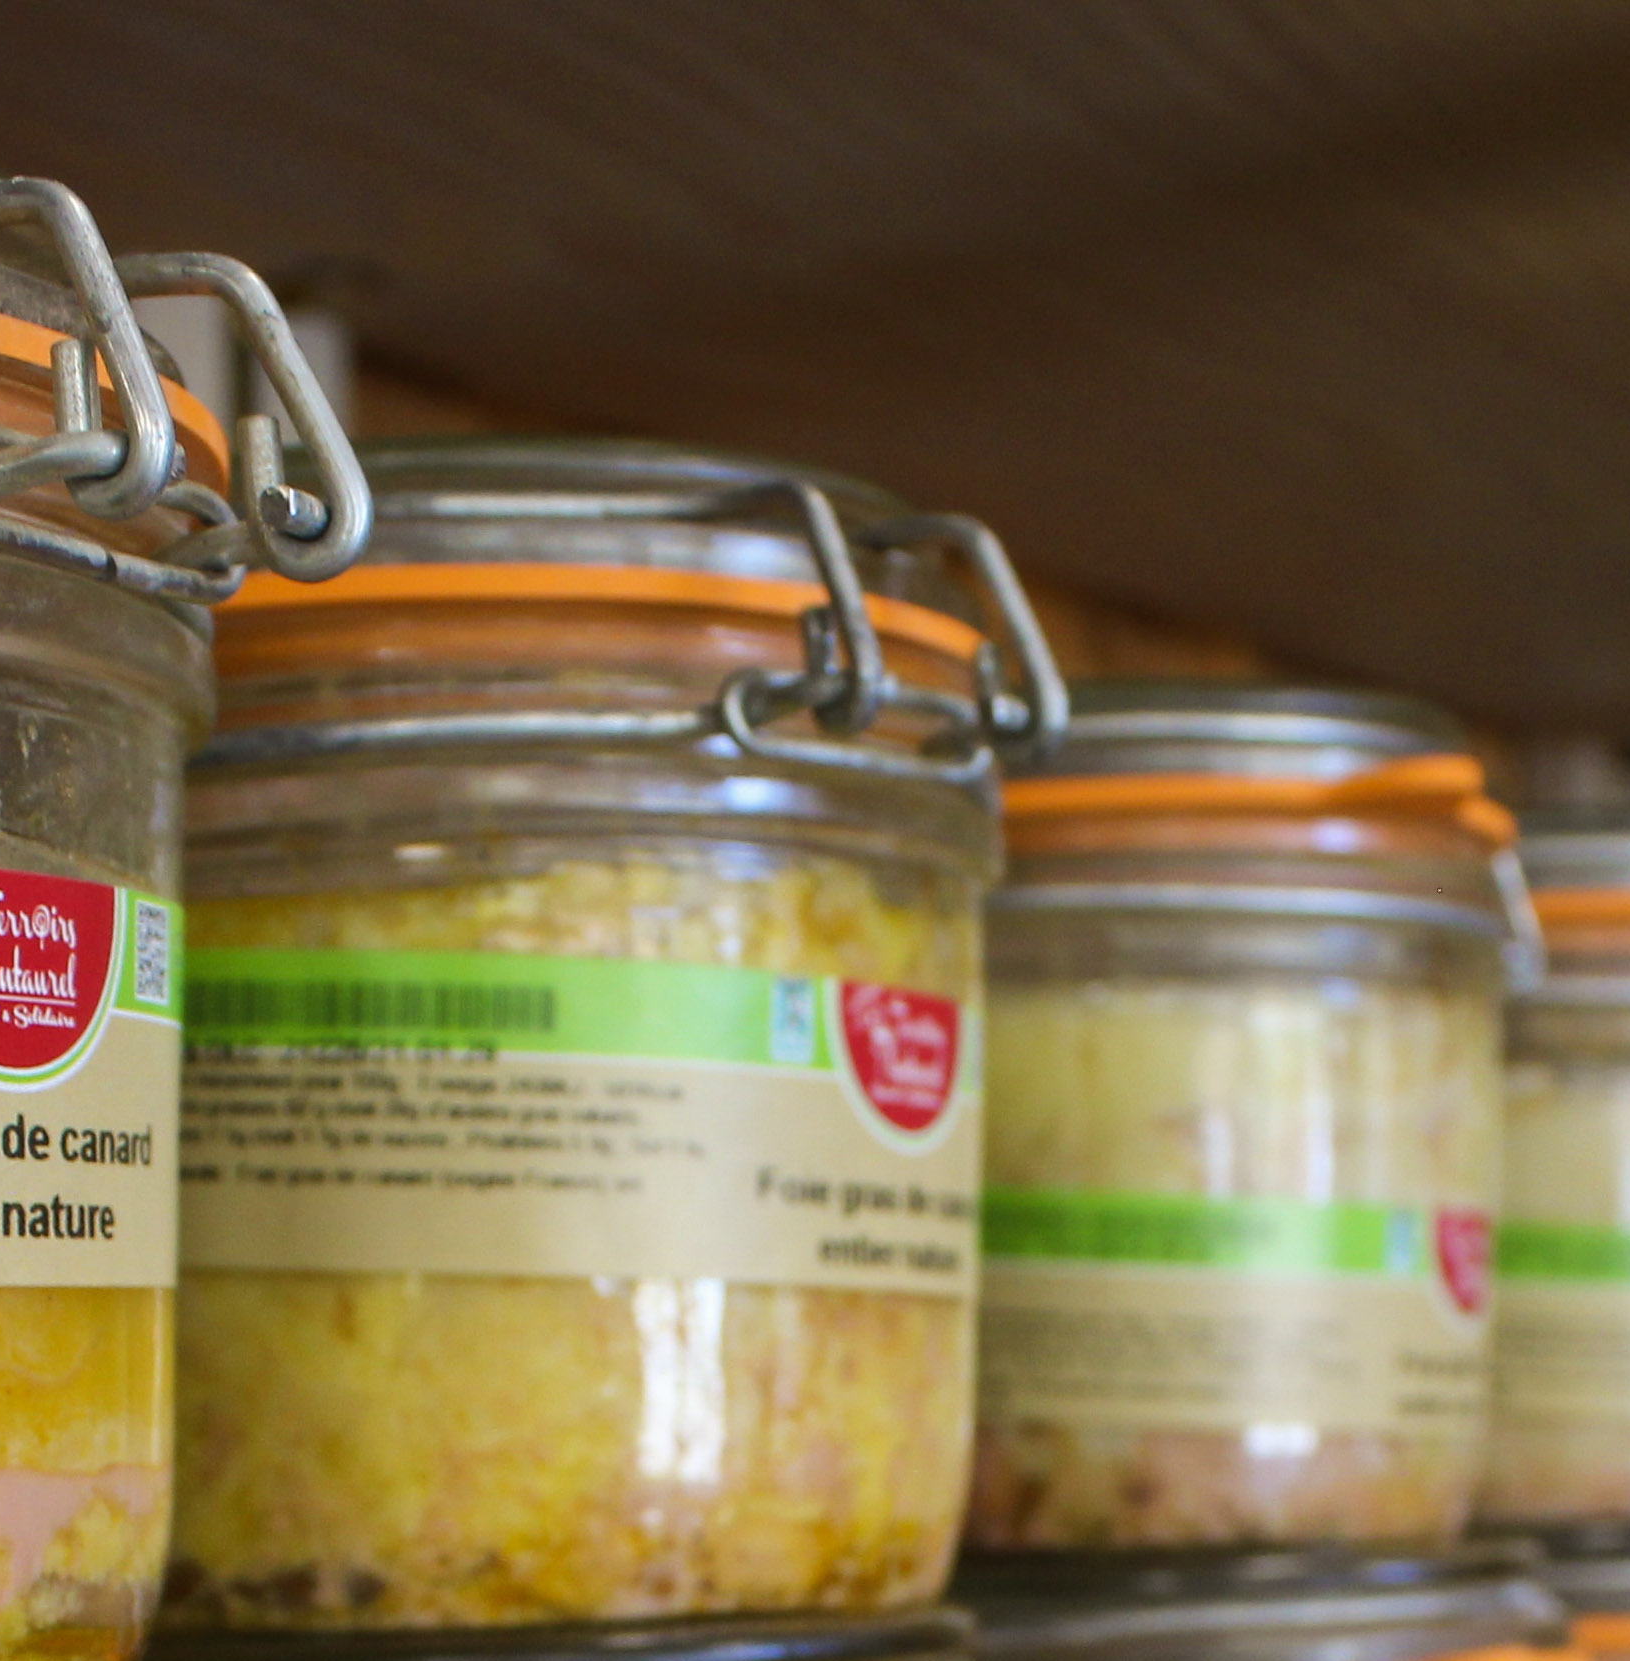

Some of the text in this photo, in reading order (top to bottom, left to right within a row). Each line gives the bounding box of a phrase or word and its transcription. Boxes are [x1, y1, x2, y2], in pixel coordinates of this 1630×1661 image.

[0, 1114, 47, 1160] de
[59, 1119, 152, 1166] canard
[0, 1193, 116, 1241] nature
